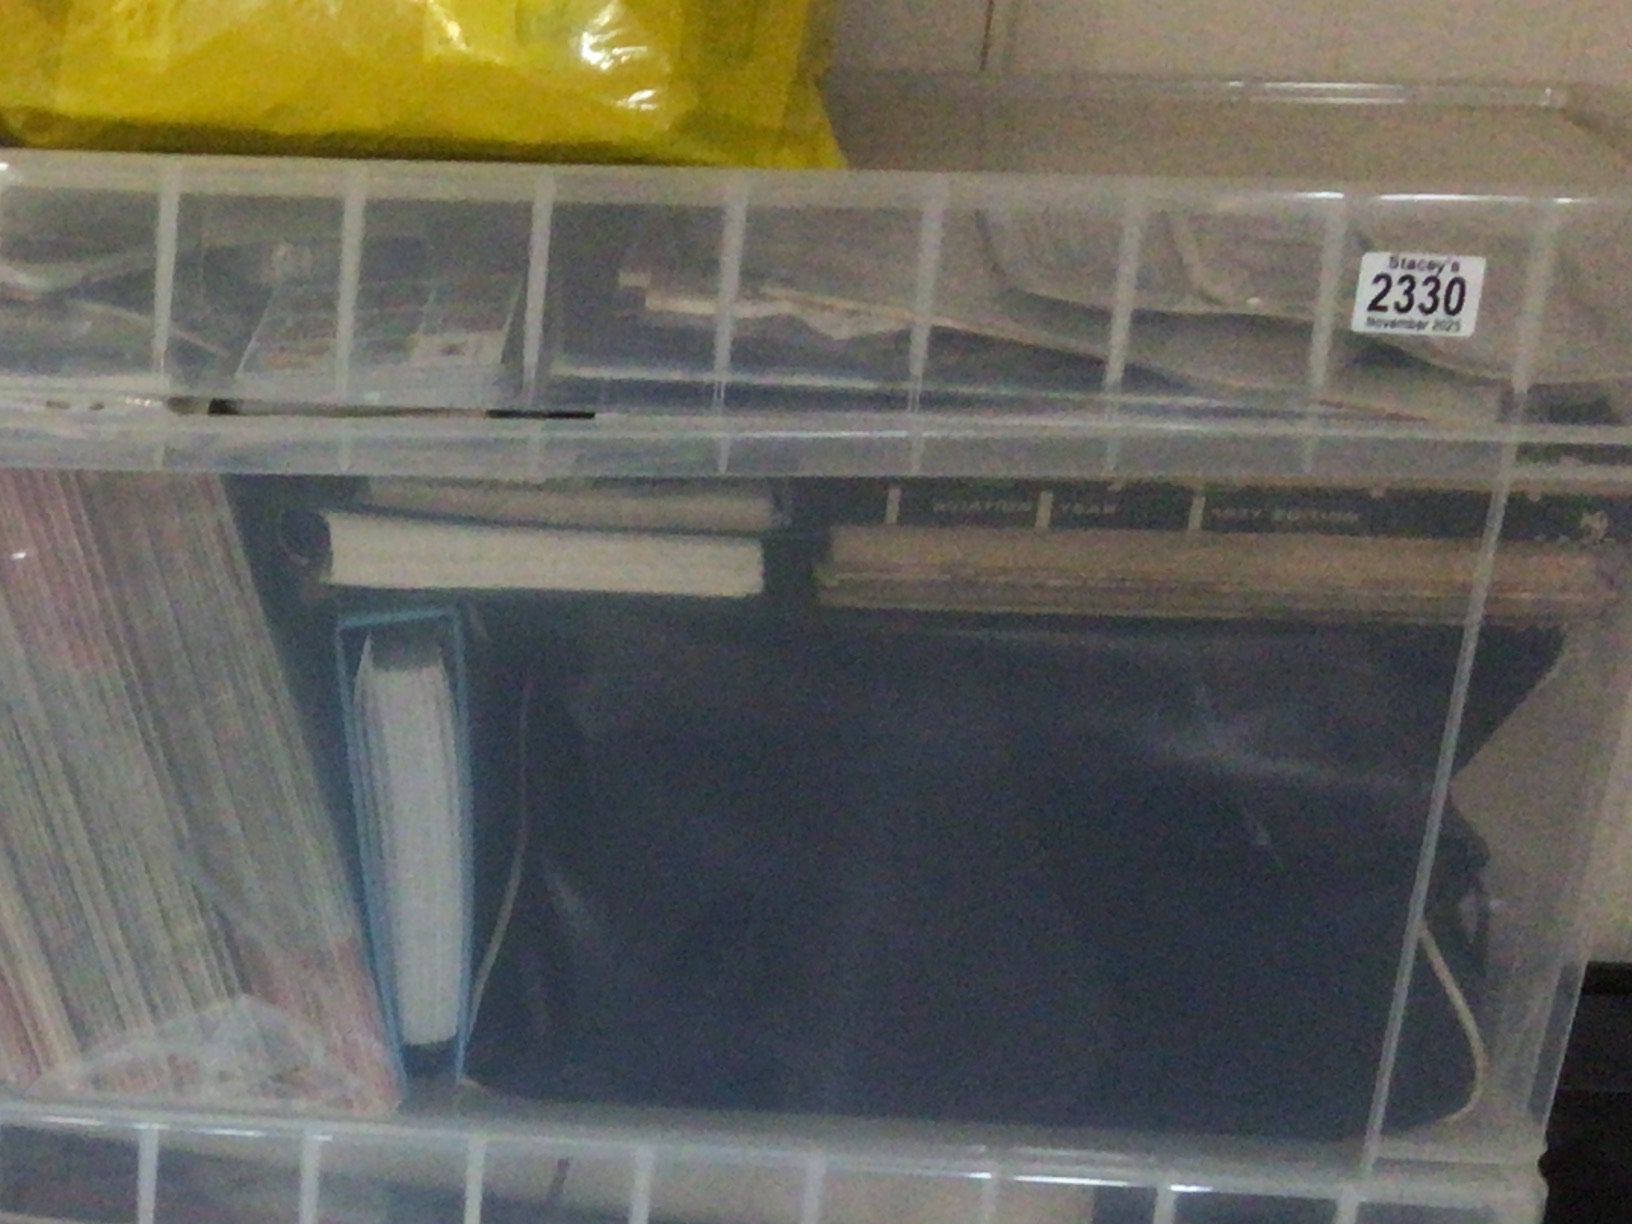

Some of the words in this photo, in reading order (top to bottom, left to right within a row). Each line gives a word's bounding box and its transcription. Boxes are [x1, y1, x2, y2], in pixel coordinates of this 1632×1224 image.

[1389, 256, 1460, 276] Stacey's
[1367, 273, 1466, 316] 2330
[1366, 317, 1429, 331] November
